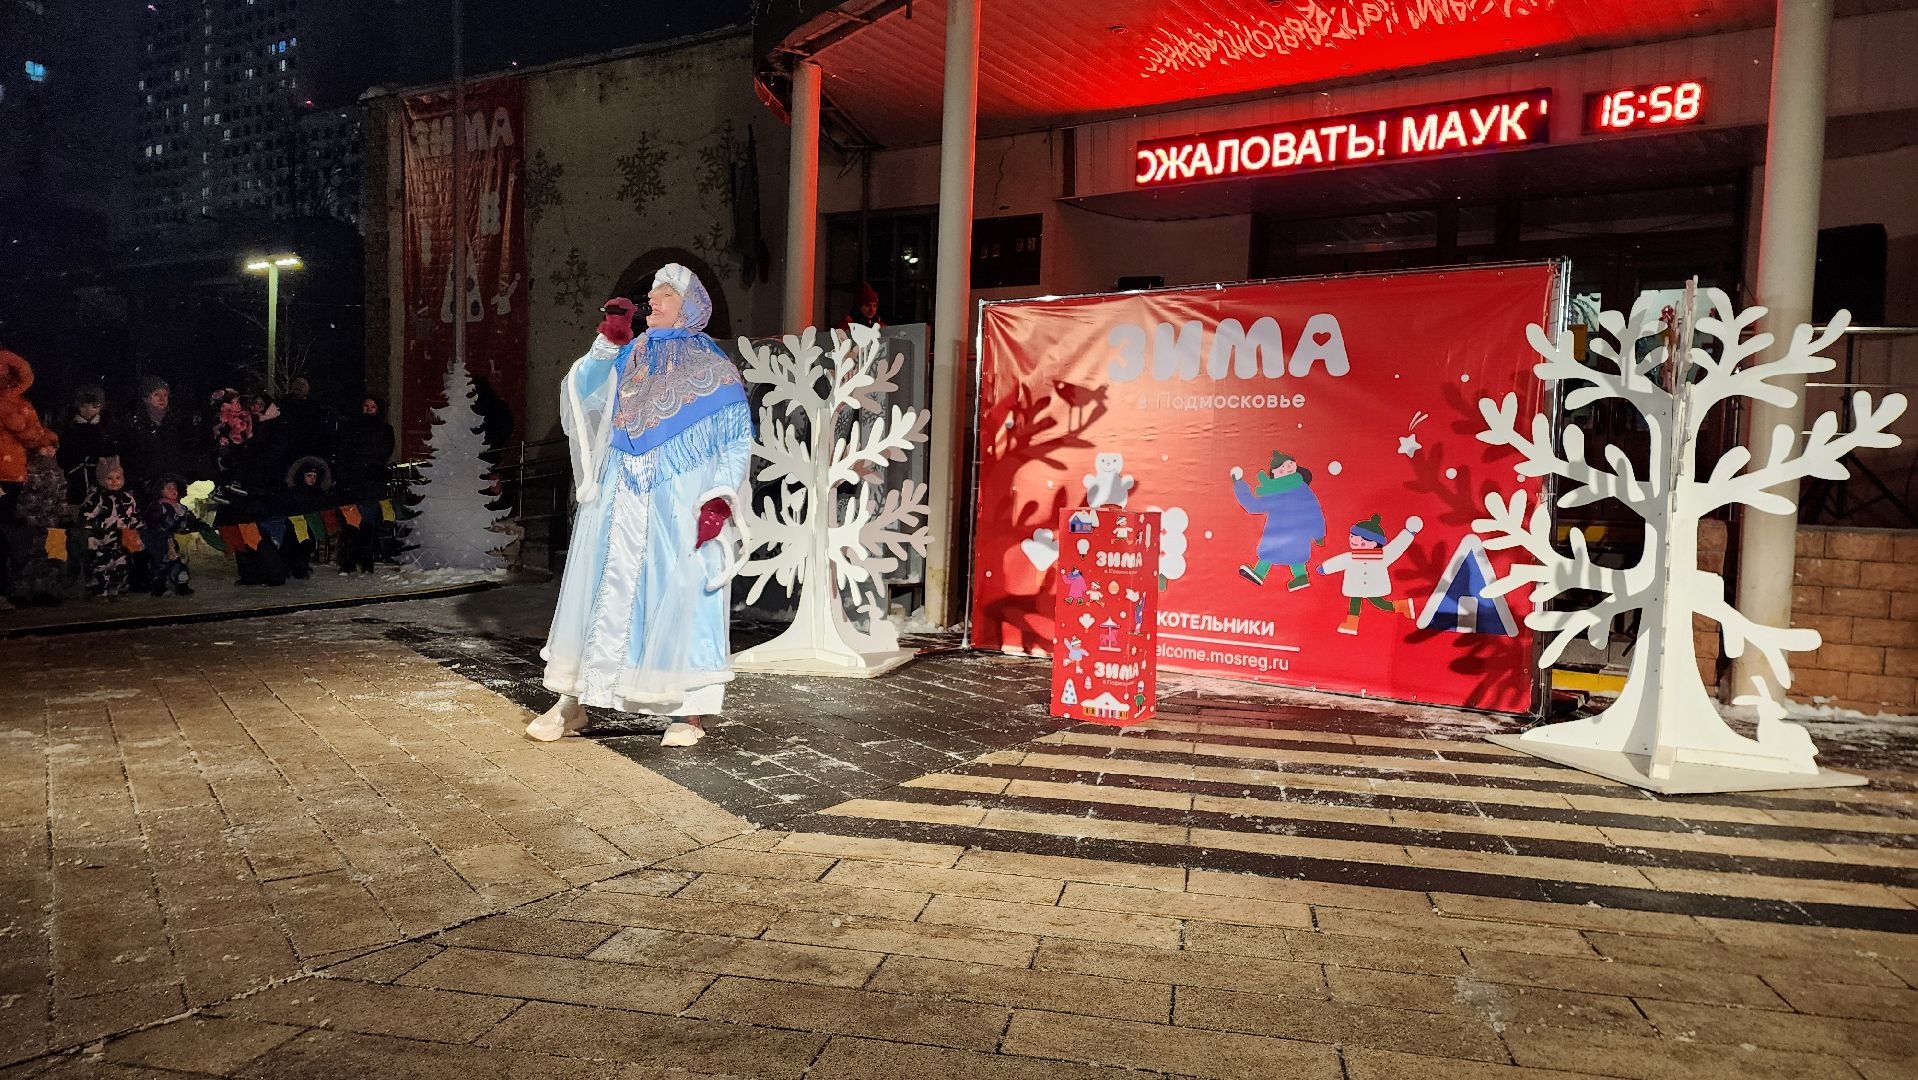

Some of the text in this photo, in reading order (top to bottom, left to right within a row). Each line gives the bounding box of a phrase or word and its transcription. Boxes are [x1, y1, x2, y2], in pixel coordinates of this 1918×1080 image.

[1600, 82, 1701, 128] 16:58
[1401, 101, 1530, 153] МАУК
[1108, 313, 1350, 383] ЗИМА
[1157, 392, 1306, 411] Подмосковье
[1096, 551, 1142, 568] ЗИМА
[1157, 610, 1275, 637] КОТЕЛЬНИКИ
[1094, 661, 1139, 681] ЗИМА
[1156, 643, 1289, 672] elcome.mosreg.ru
